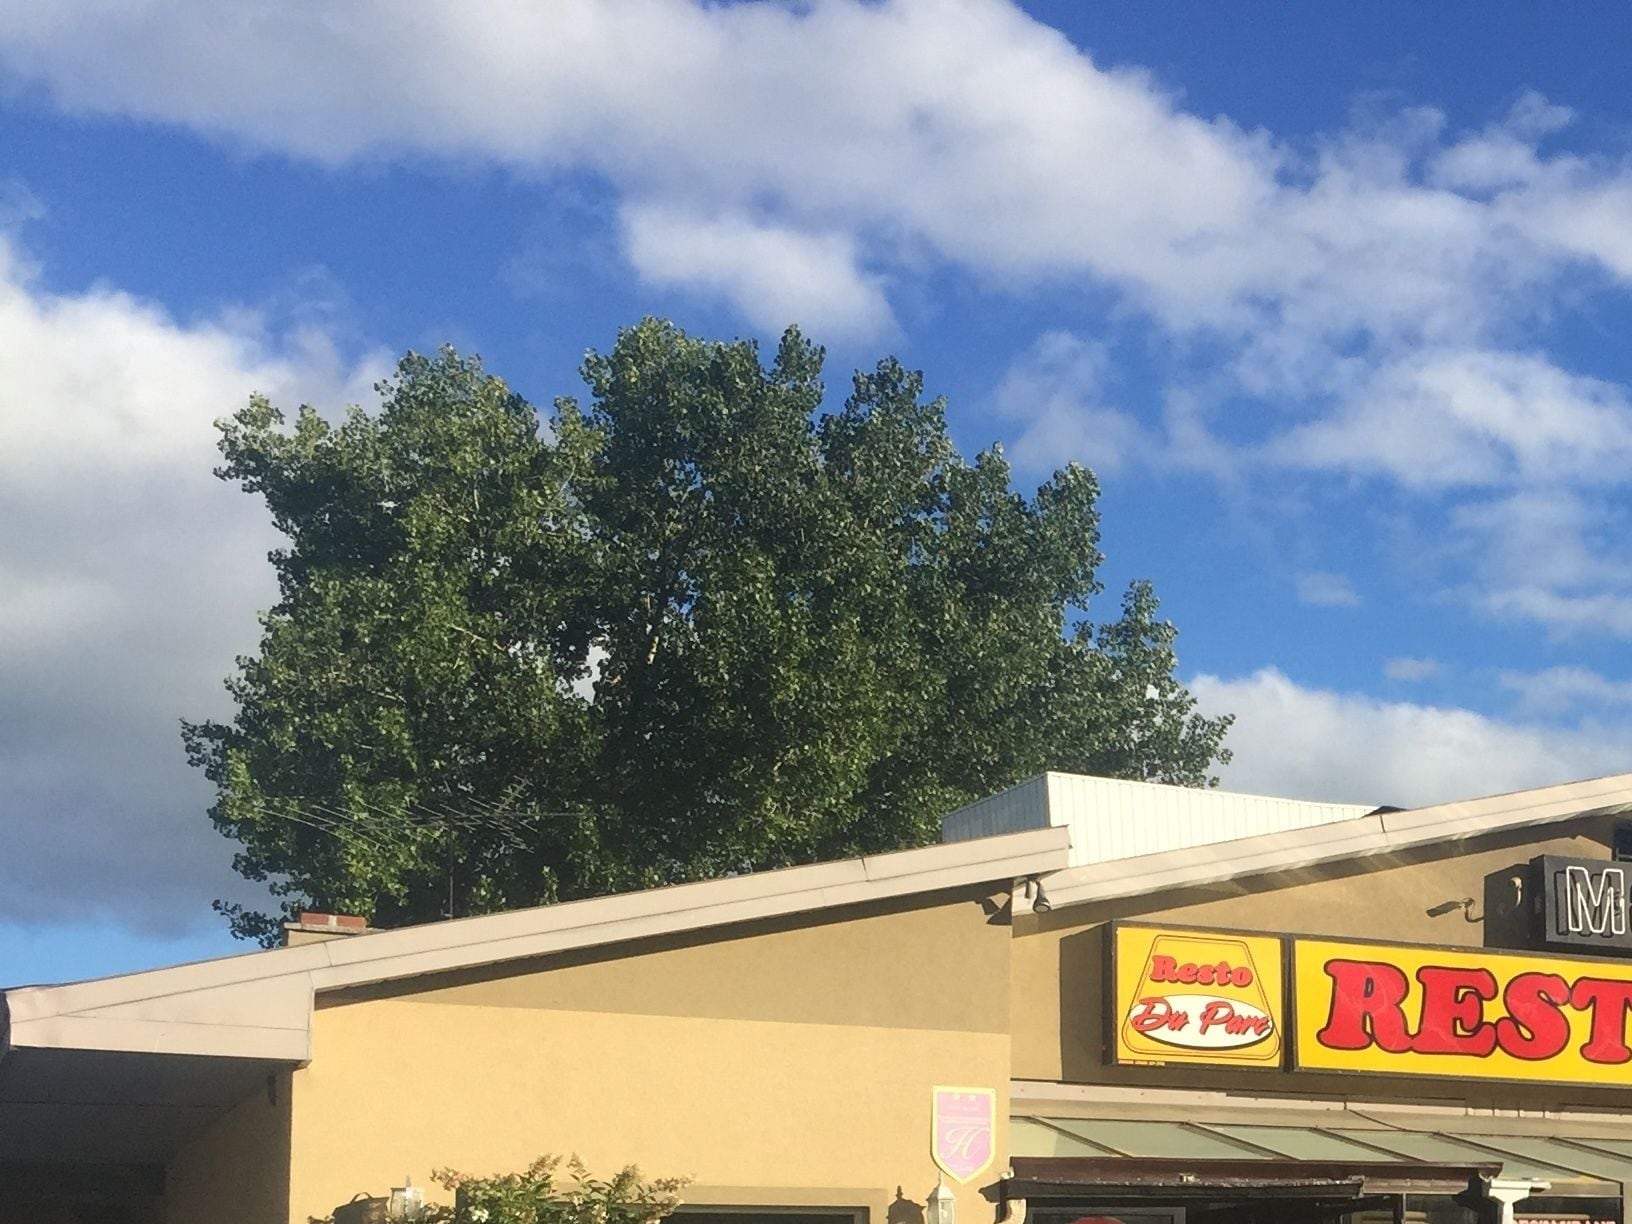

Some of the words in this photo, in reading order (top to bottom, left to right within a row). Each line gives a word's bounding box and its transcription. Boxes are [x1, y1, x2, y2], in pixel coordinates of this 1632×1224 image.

[1150, 954, 1253, 988] Resto
[1132, 996, 1190, 1033] Du
[1199, 1000, 1272, 1037] Parc
